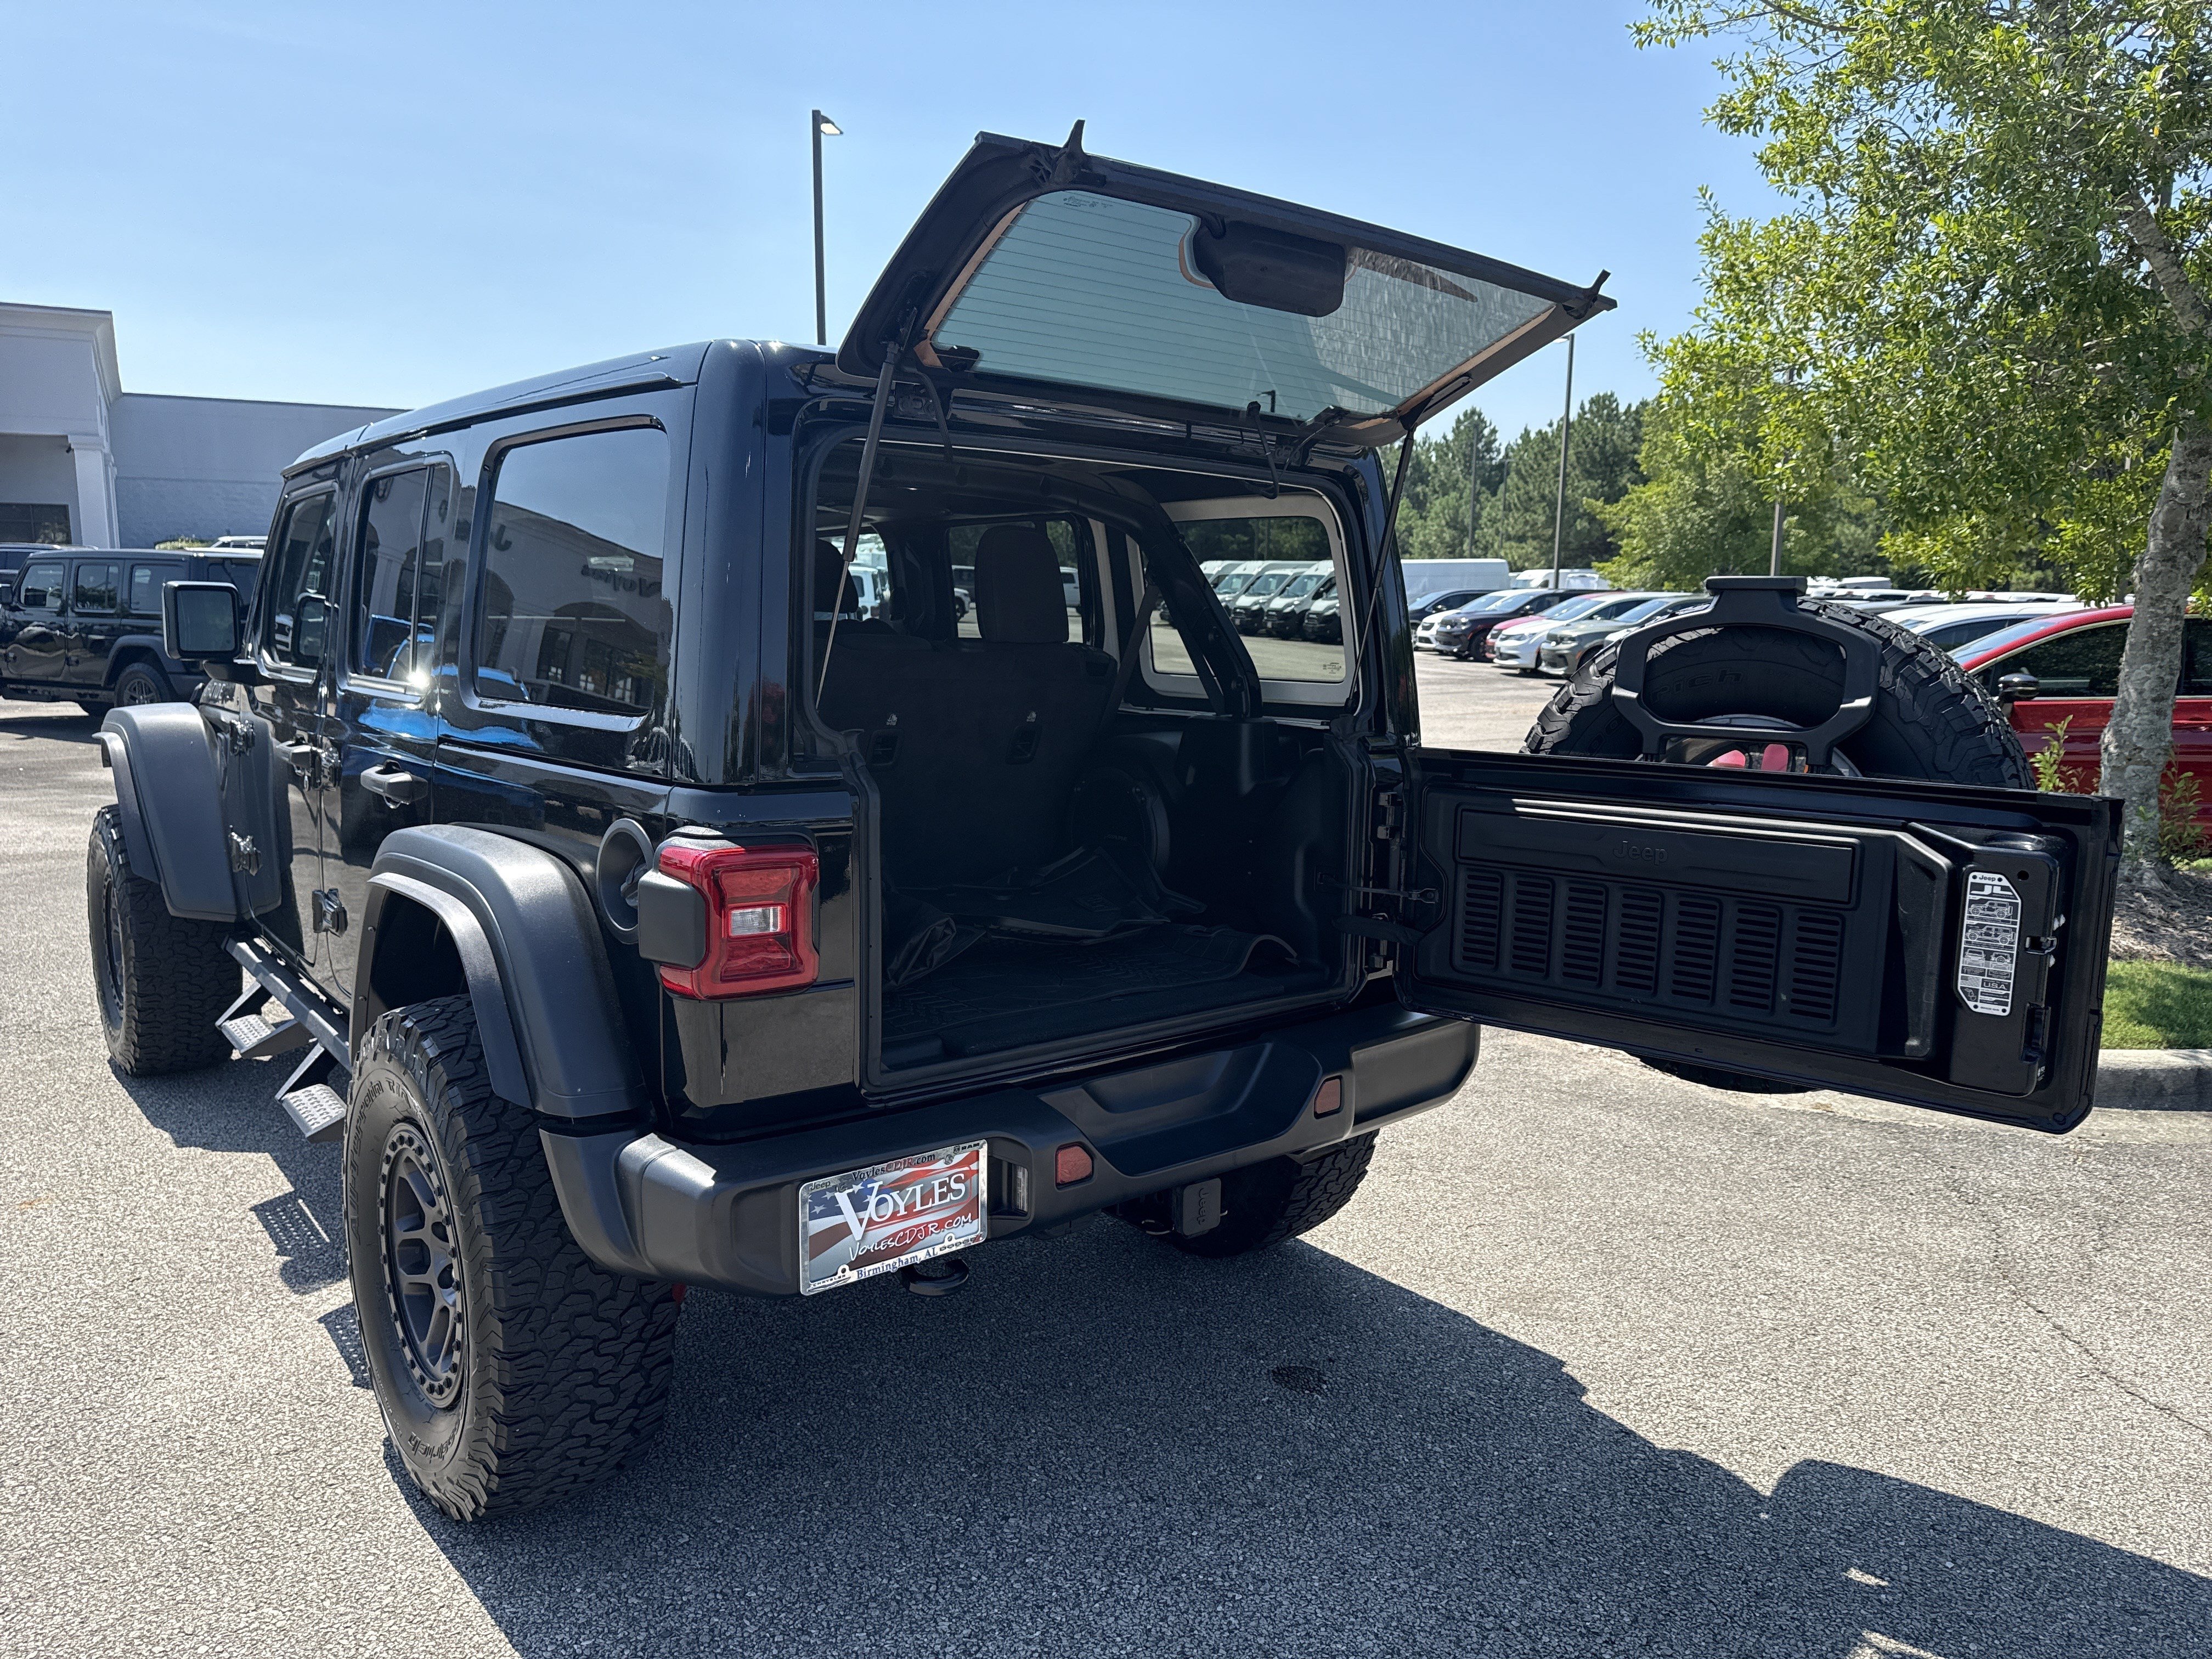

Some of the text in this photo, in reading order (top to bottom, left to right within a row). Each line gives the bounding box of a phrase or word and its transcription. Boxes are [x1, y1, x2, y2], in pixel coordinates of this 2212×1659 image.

[1613, 840, 1668, 866] Jeep
[1983, 981, 2008, 990] USA
[853, 1153, 936, 1181] VoylesCDJR.com
[810, 1181, 831, 1190] Jeep
[834, 1173, 966, 1241] VOYLES
[1197, 1187, 1209, 1226] Jeep
[856, 1247, 938, 1280] Birmingham, AL
